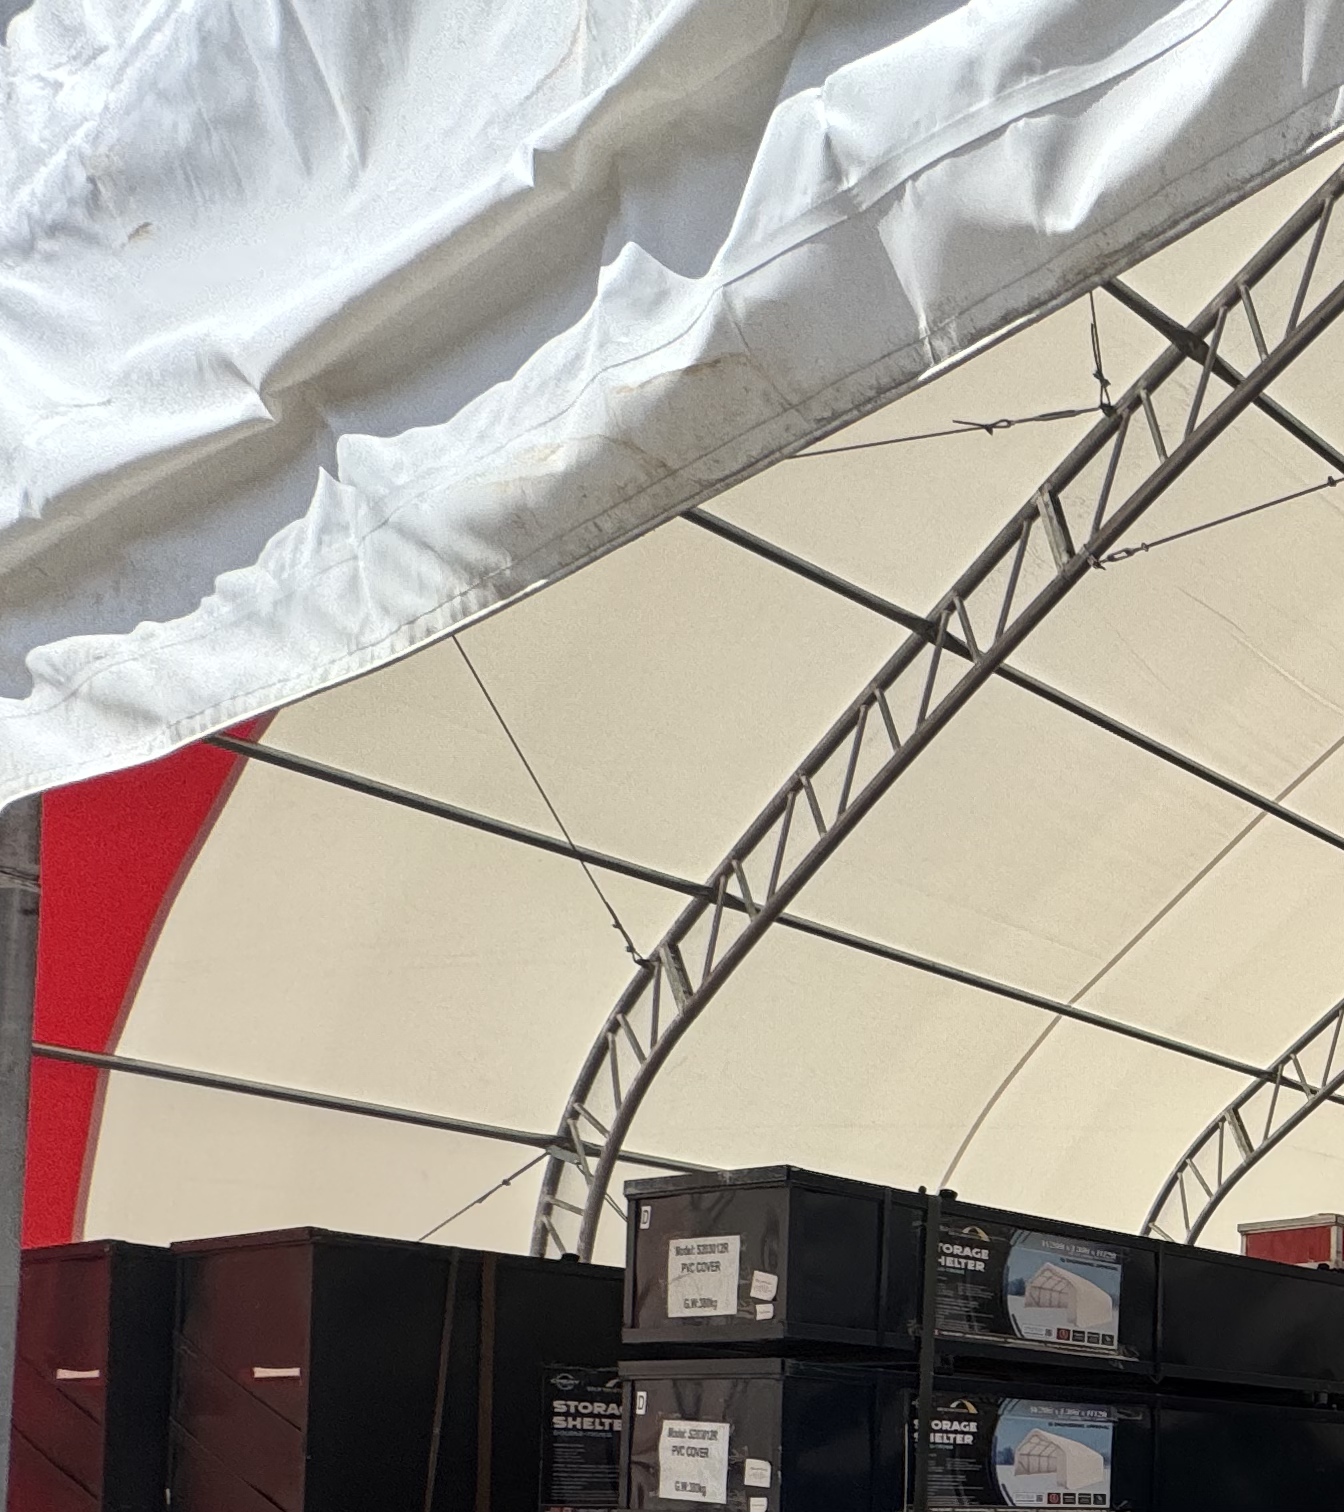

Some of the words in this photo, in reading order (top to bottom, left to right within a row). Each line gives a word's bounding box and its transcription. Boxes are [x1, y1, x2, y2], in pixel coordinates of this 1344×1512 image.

[938, 1242, 989, 1260] TORAGE
[696, 1261, 721, 1273] COVER
[938, 1257, 985, 1273] HELTER
[552, 1400, 622, 1415] STORA
[552, 1416, 622, 1431] SHELTE
[686, 1447, 709, 1458] COVER
